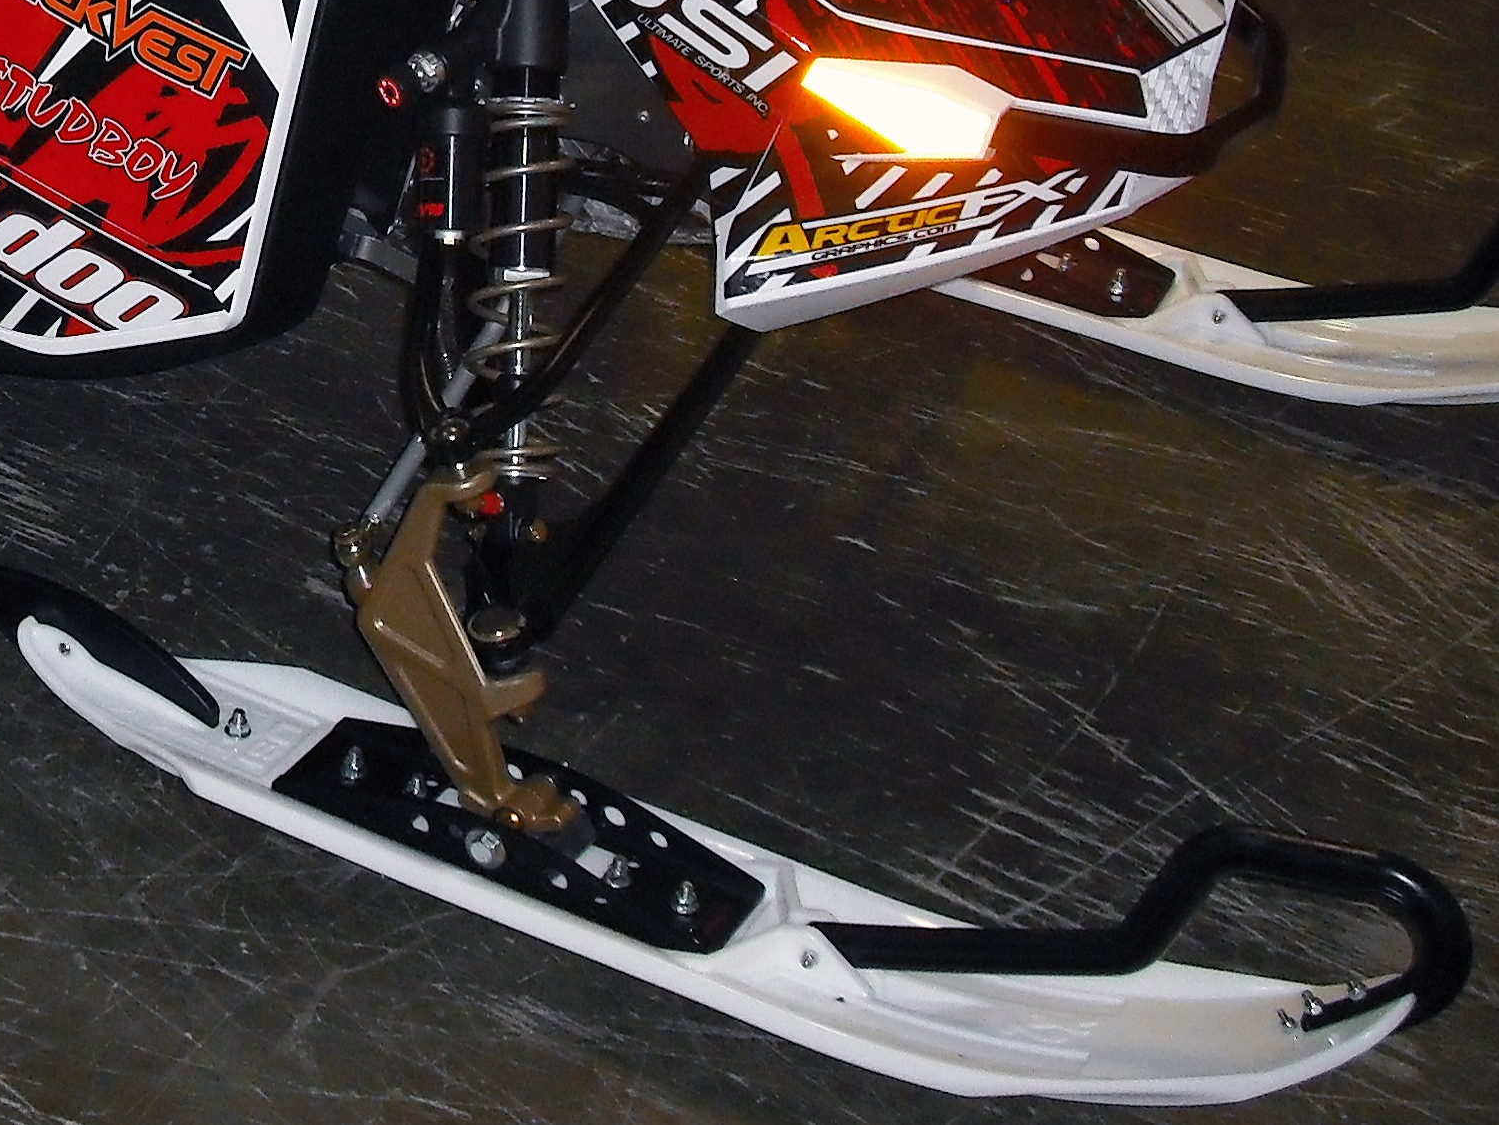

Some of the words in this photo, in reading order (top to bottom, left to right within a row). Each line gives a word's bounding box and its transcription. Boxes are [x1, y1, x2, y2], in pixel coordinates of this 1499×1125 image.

[636, 12, 694, 57] ULTIMATE
[693, 52, 746, 95] SPORTS
[745, 92, 770, 117] INC.
